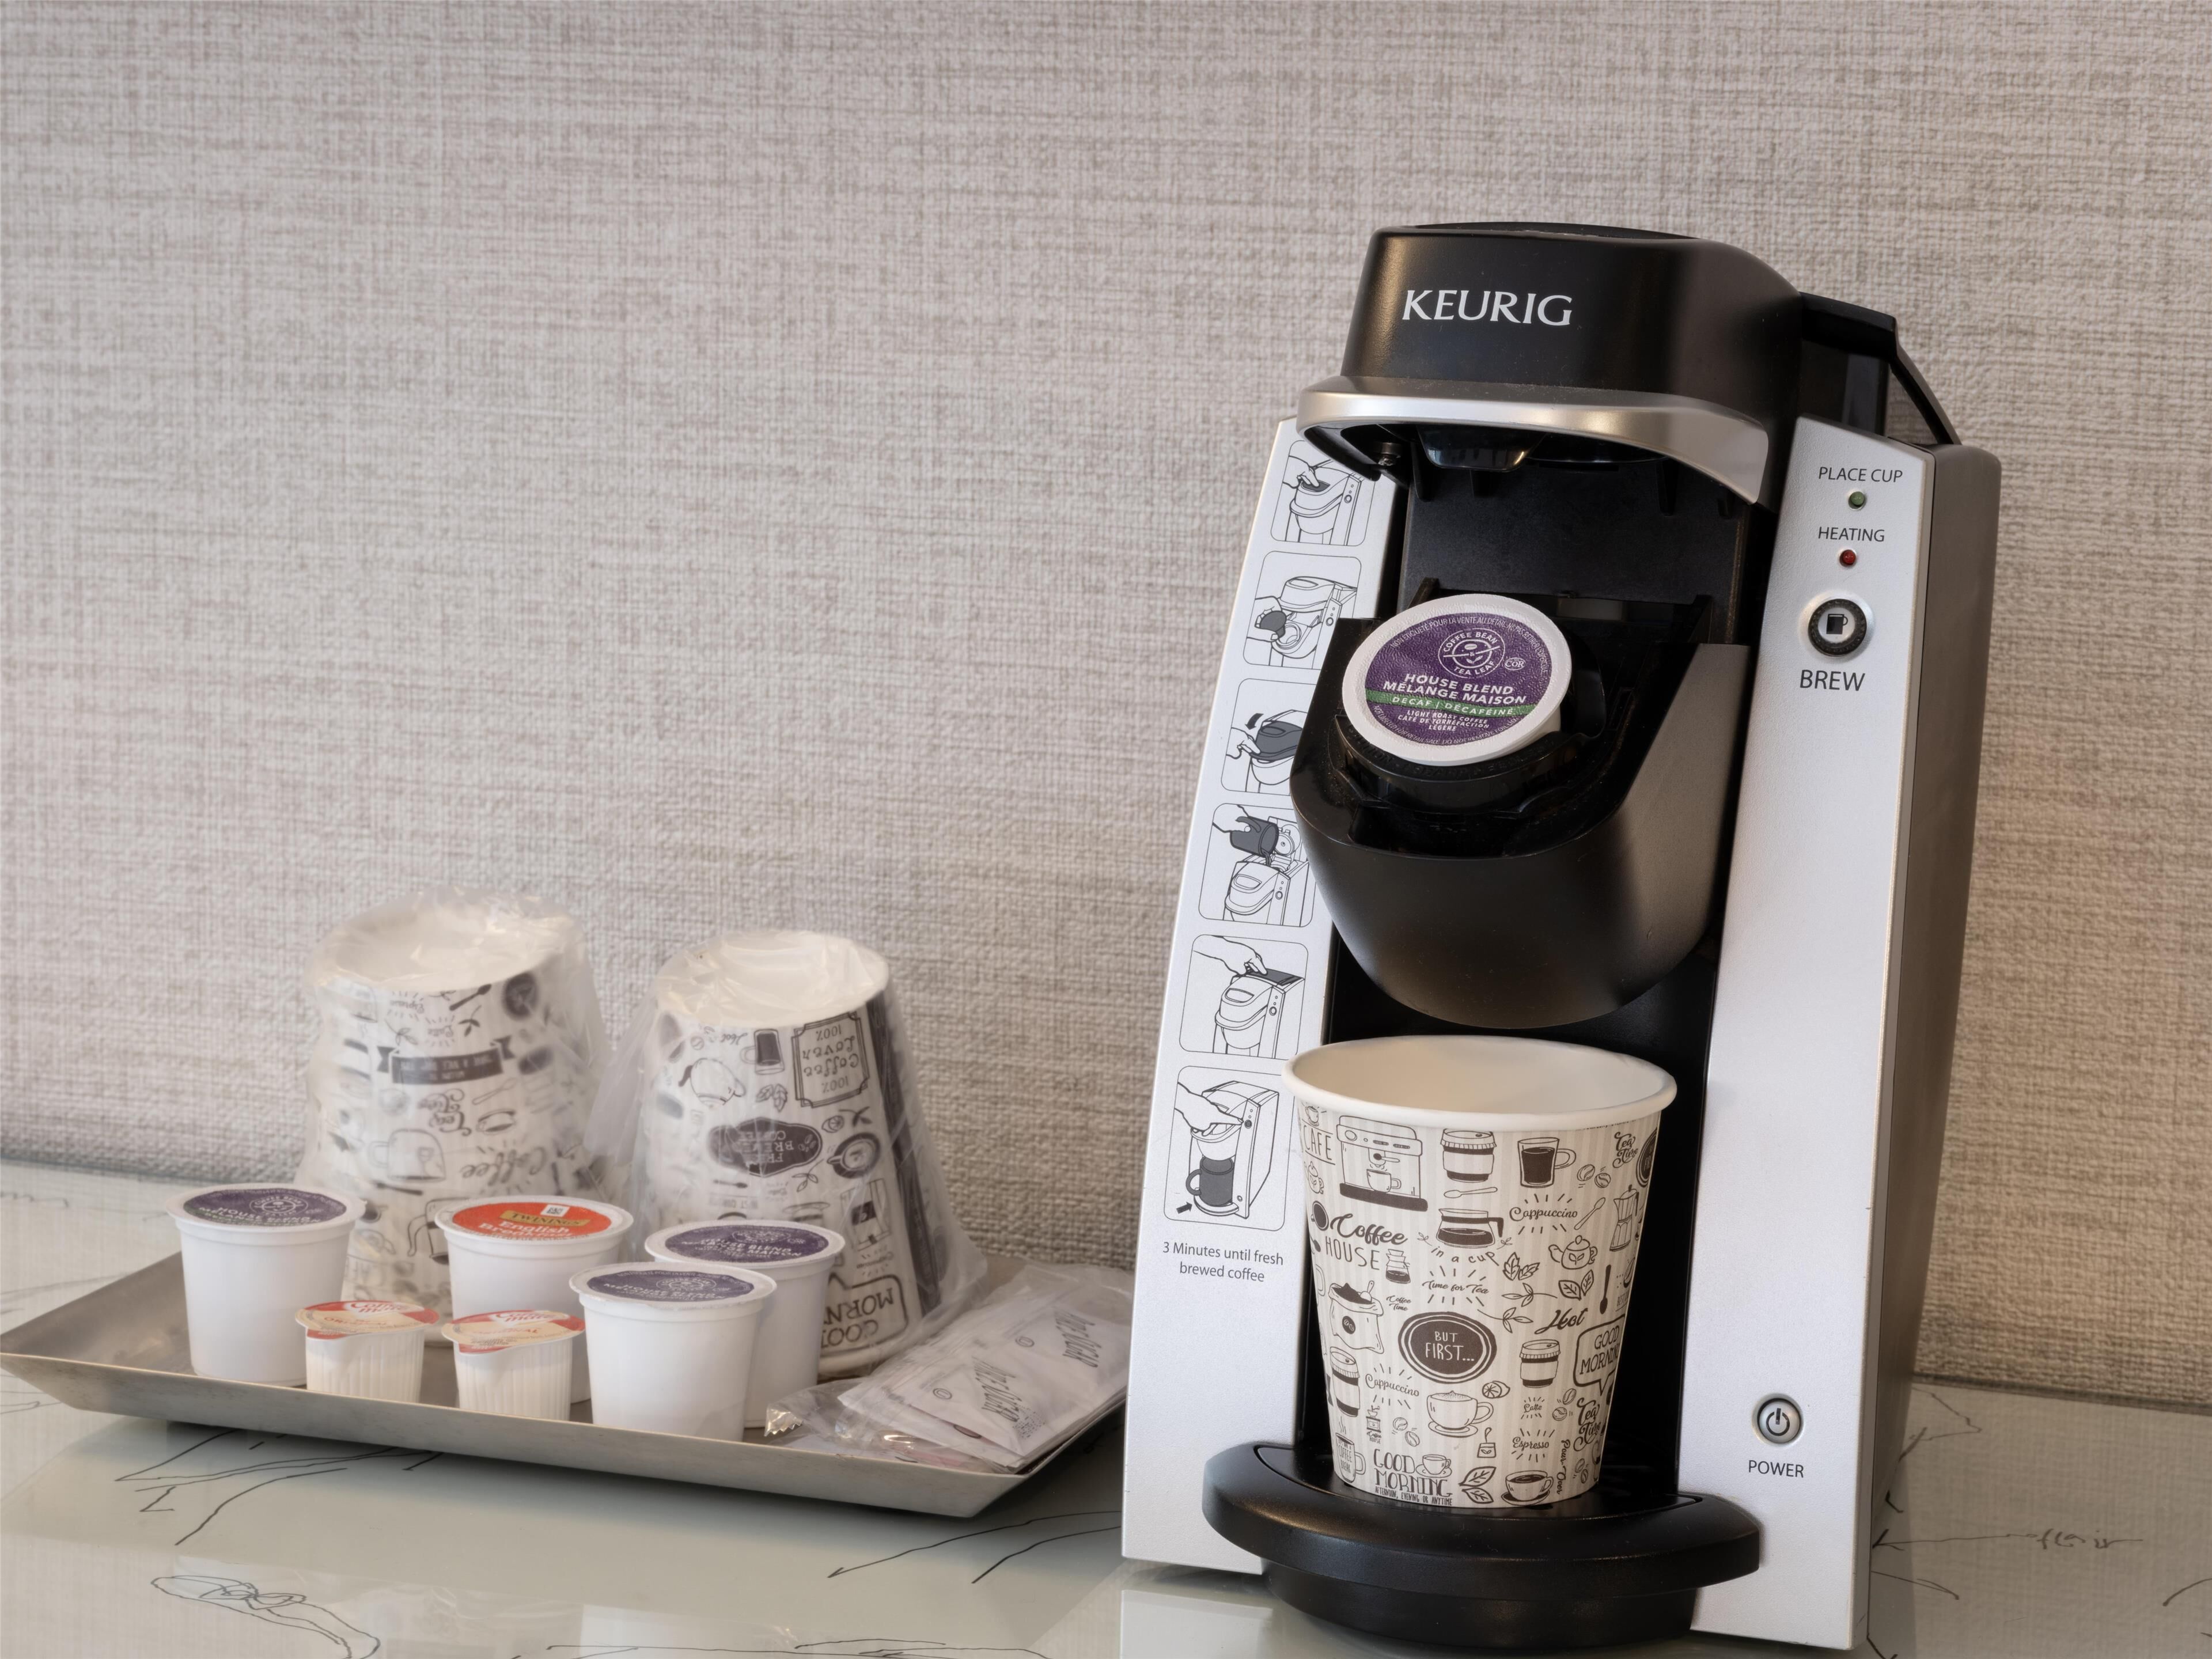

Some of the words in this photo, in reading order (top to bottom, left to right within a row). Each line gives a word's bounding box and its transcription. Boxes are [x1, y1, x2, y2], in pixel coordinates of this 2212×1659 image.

[1402, 290, 1573, 326] KEURIG
[1818, 466, 1867, 482] PLACE
[1870, 469, 1903, 483] CUP
[1818, 526, 1885, 542] HEATING
[1429, 619, 1448, 628] POUR
[1443, 632, 1472, 652] COFFEE
[1475, 632, 1498, 644] BEAN
[1454, 666, 1471, 675] TEA
[1474, 661, 1495, 675] LEAF
[1404, 673, 1459, 690] HOUSE
[1463, 683, 1513, 695] BLEND
[1800, 669, 1865, 691] BREW
[1383, 681, 1458, 699] MÉLANGE
[1462, 693, 1527, 704] MAISON
[1392, 696, 1433, 707] DECAF
[1407, 710, 1430, 718] LIGHT
[815, 1024, 842, 1041] 100%
[803, 1053, 859, 1078] Coffee
[821, 1075, 849, 1094] 100%
[1303, 1124, 1332, 1161] CAFE
[1614, 1131, 1636, 1151] Tea
[1509, 1207, 1578, 1222] Cappuccino
[499, 1221, 570, 1234] English
[1330, 1213, 1408, 1245] Coffee
[1162, 1241, 1170, 1253] 3
[1173, 1242, 1221, 1257] Minutes
[1224, 1249, 1251, 1262] until
[1254, 1250, 1284, 1266] fresh
[1325, 1236, 1380, 1271] HOUSE
[1431, 1246, 1445, 1257] in
[1468, 1251, 1499, 1266] cup
[1180, 1262, 1225, 1277] brewed
[1228, 1267, 1265, 1282] coffee
[1422, 1279, 1449, 1290] Time
[1450, 1283, 1465, 1292] for
[1466, 1284, 1490, 1294] Tea
[824, 1287, 894, 1324] MORN
[1386, 1295, 1412, 1304] Coffee
[1389, 1303, 1408, 1311] Time
[1535, 1308, 1588, 1335] Hot
[1434, 1331, 1459, 1343] BUT
[1594, 1325, 1620, 1350] GOOD
[1365, 1373, 1420, 1397] Cappuccino
[1524, 1403, 1543, 1413] Latte
[1576, 1397, 1600, 1426] Tea
[1512, 1436, 1550, 1452] Espresso
[1373, 1448, 1416, 1474] GOOD
[1748, 1460, 1804, 1478] POWER
[1374, 1468, 1453, 1498] MORNING
[1431, 1496, 1453, 1506] ANYTIME
